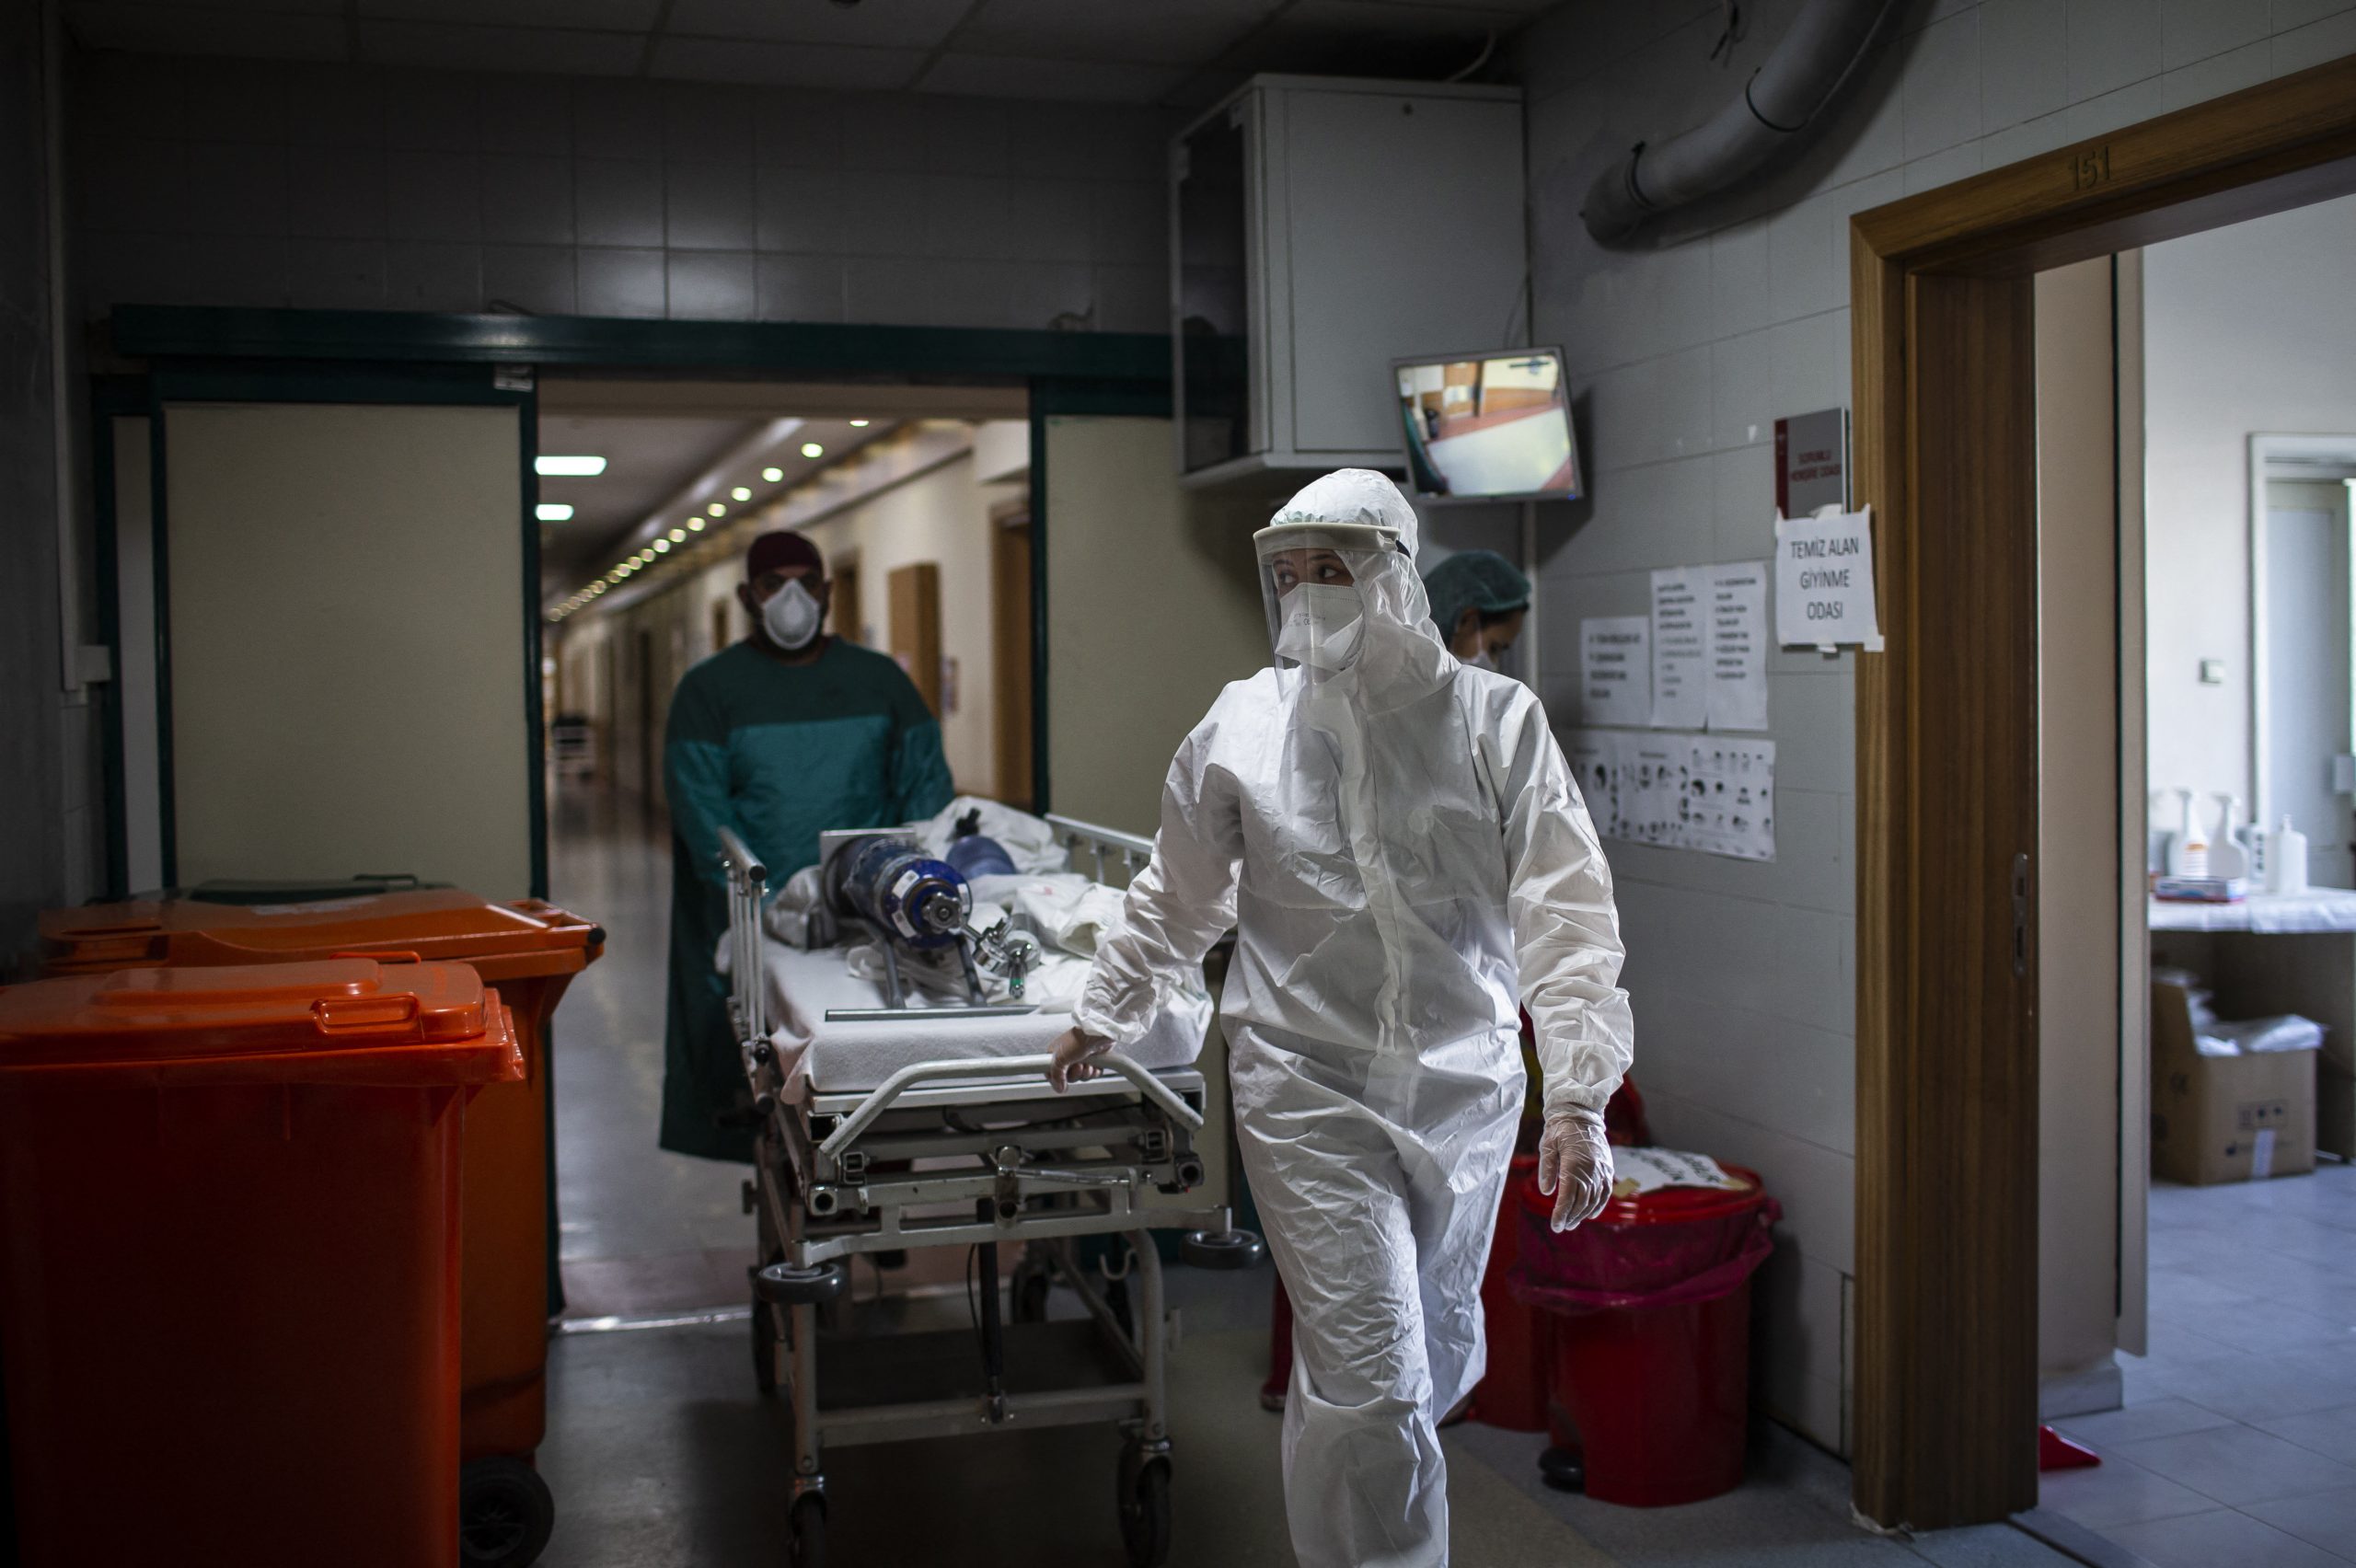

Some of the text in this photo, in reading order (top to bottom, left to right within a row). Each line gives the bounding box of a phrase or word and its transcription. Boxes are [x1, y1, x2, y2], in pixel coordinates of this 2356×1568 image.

[2068, 144, 2110, 191] 151
[1790, 536, 1859, 559] TEMİZ ALAN
[1800, 567, 1850, 590] GİYİNME
[1807, 601, 1843, 621] ODASI
